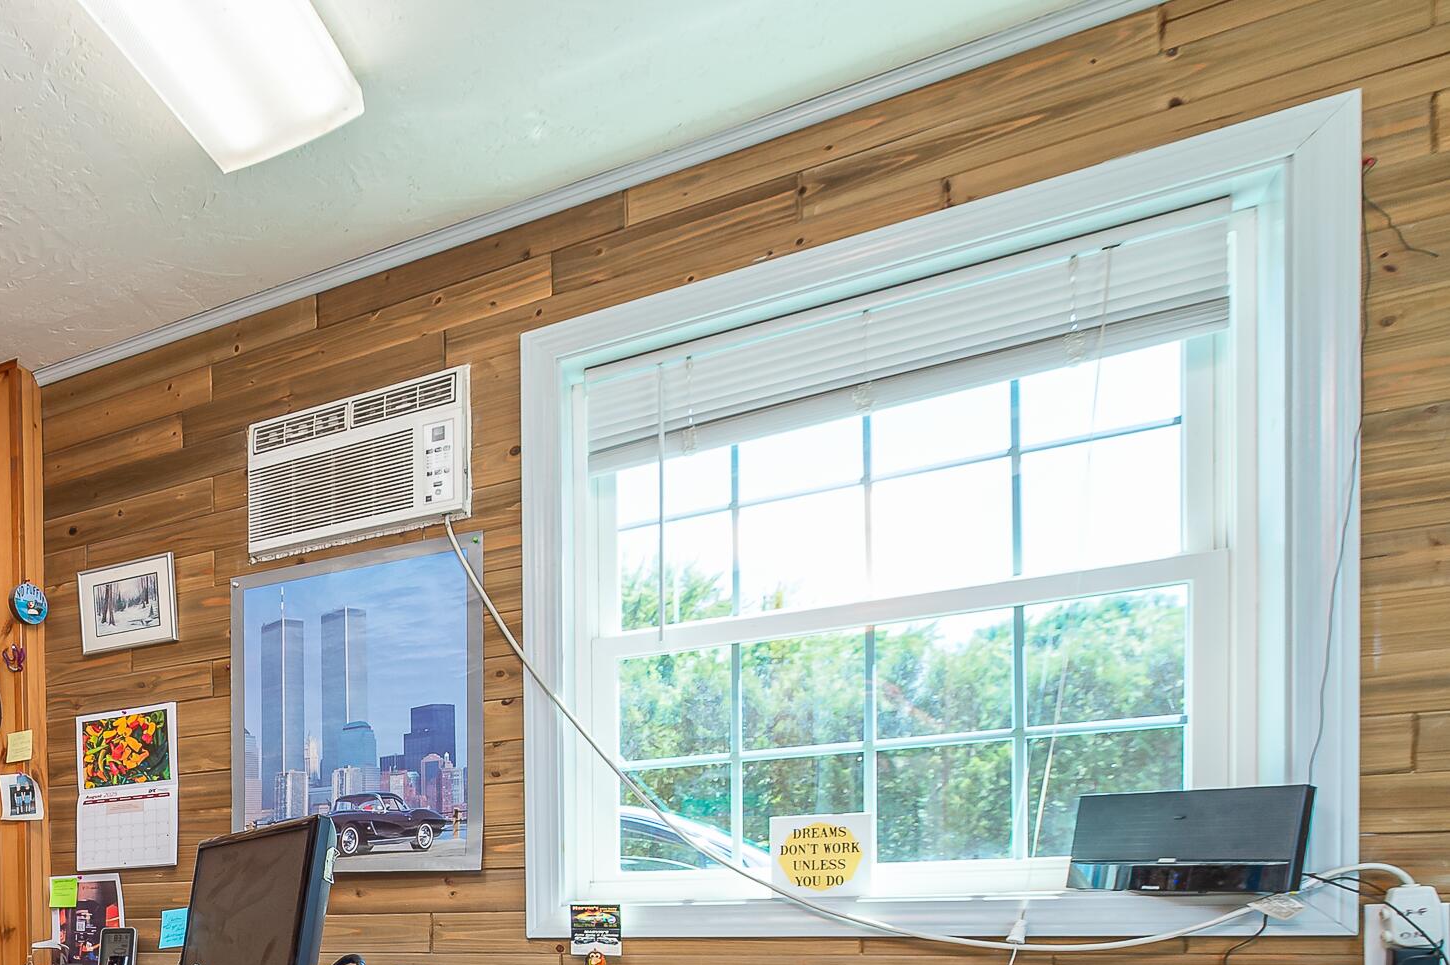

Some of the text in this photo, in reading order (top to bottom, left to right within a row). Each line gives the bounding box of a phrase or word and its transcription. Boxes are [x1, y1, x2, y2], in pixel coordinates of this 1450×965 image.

[793, 826, 847, 840] DREAMS
[780, 842, 860, 856] DON'T WORK
[793, 859, 846, 871] UNLESS
[795, 875, 844, 887] YOU DO
